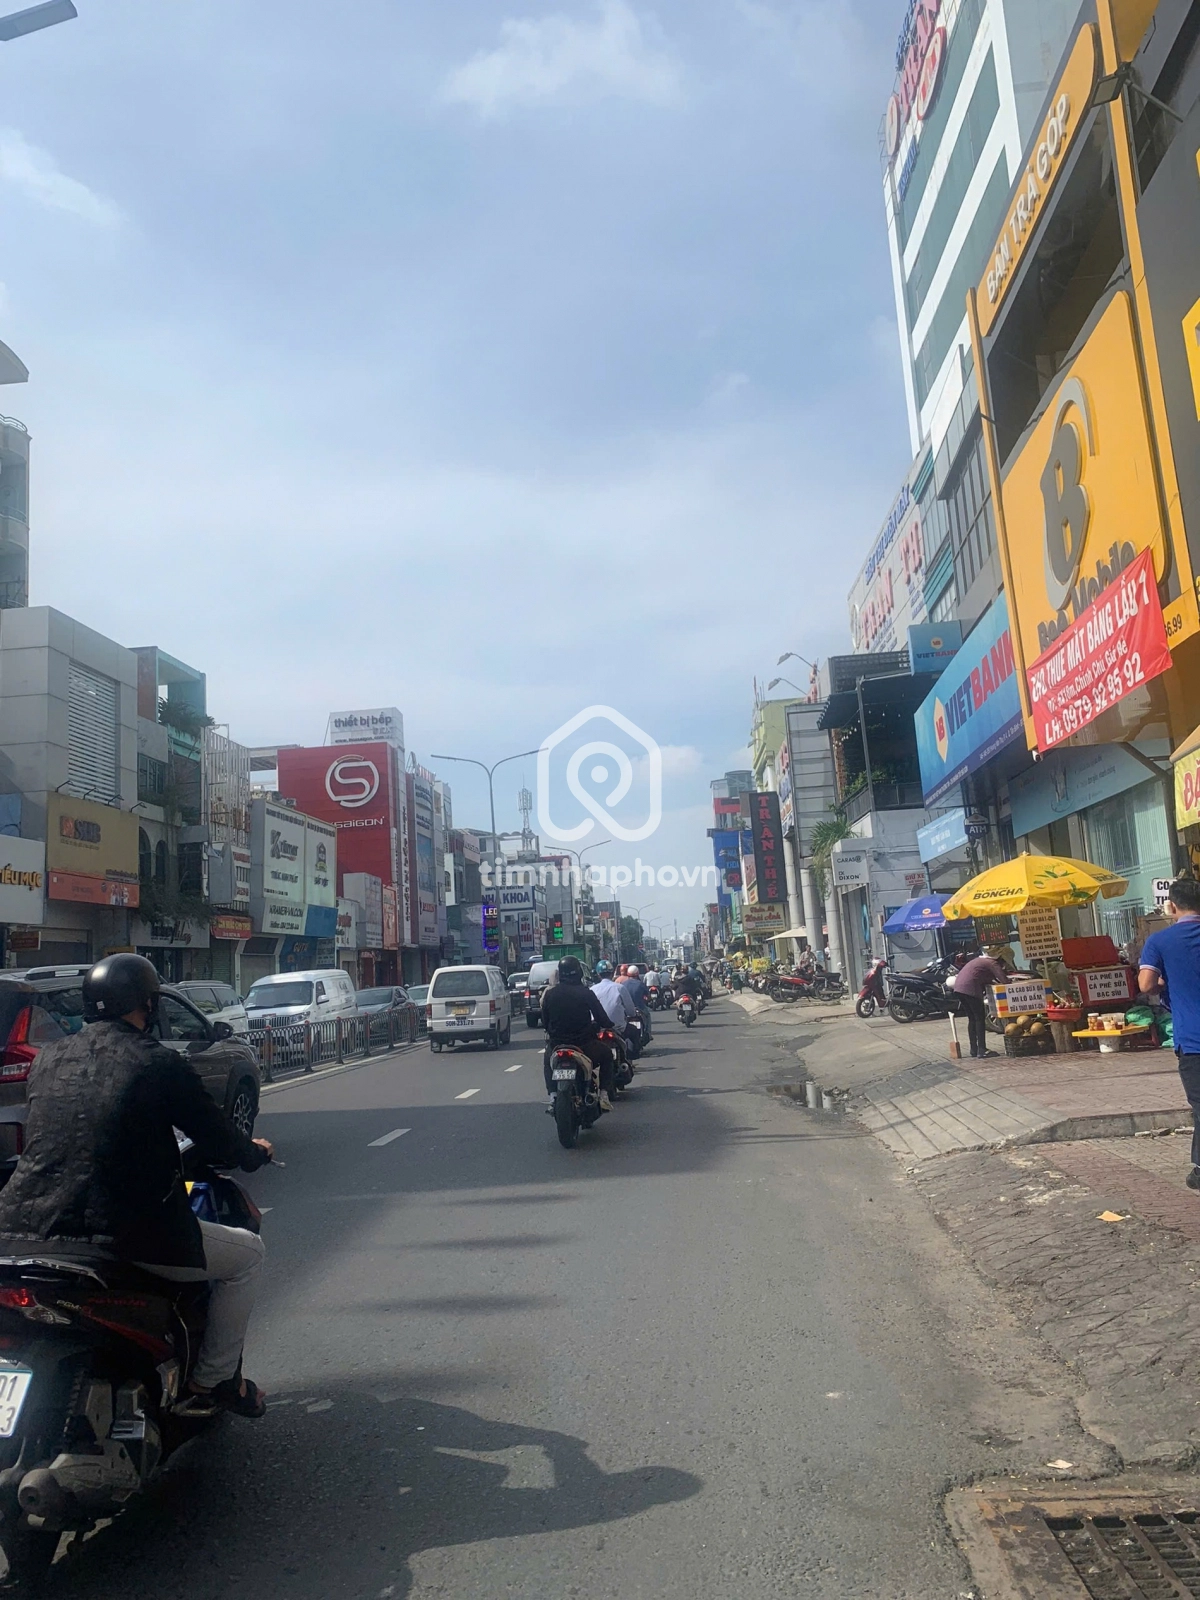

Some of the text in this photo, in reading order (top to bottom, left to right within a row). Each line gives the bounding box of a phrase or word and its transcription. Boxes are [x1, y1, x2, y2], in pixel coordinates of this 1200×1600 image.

[987, 93, 1069, 303] BÁN TRẢ GÓP
[1046, 643, 1067, 689] THUÊ
[1067, 626, 1086, 672] MẶT
[1139, 568, 1149, 605] 1
[1164, 613, 1182, 638] 6.99
[916, 649, 959, 659] VIETBAN
[1045, 717, 1063, 745] LH:
[1062, 695, 1093, 733] 0979
[1092, 682, 1107, 713] 92
[1107, 668, 1122, 700] 95
[1124, 652, 1145, 687] 92
[334, 711, 392, 728] thiết bị bếp
[969, 825, 987, 834] ATM
[0, 863, 19, 885] IẾU
[502, 892, 530, 904] KHOA
[973, 888, 1024, 900] BONCHA
[0, 1406, 16, 1433] 3
